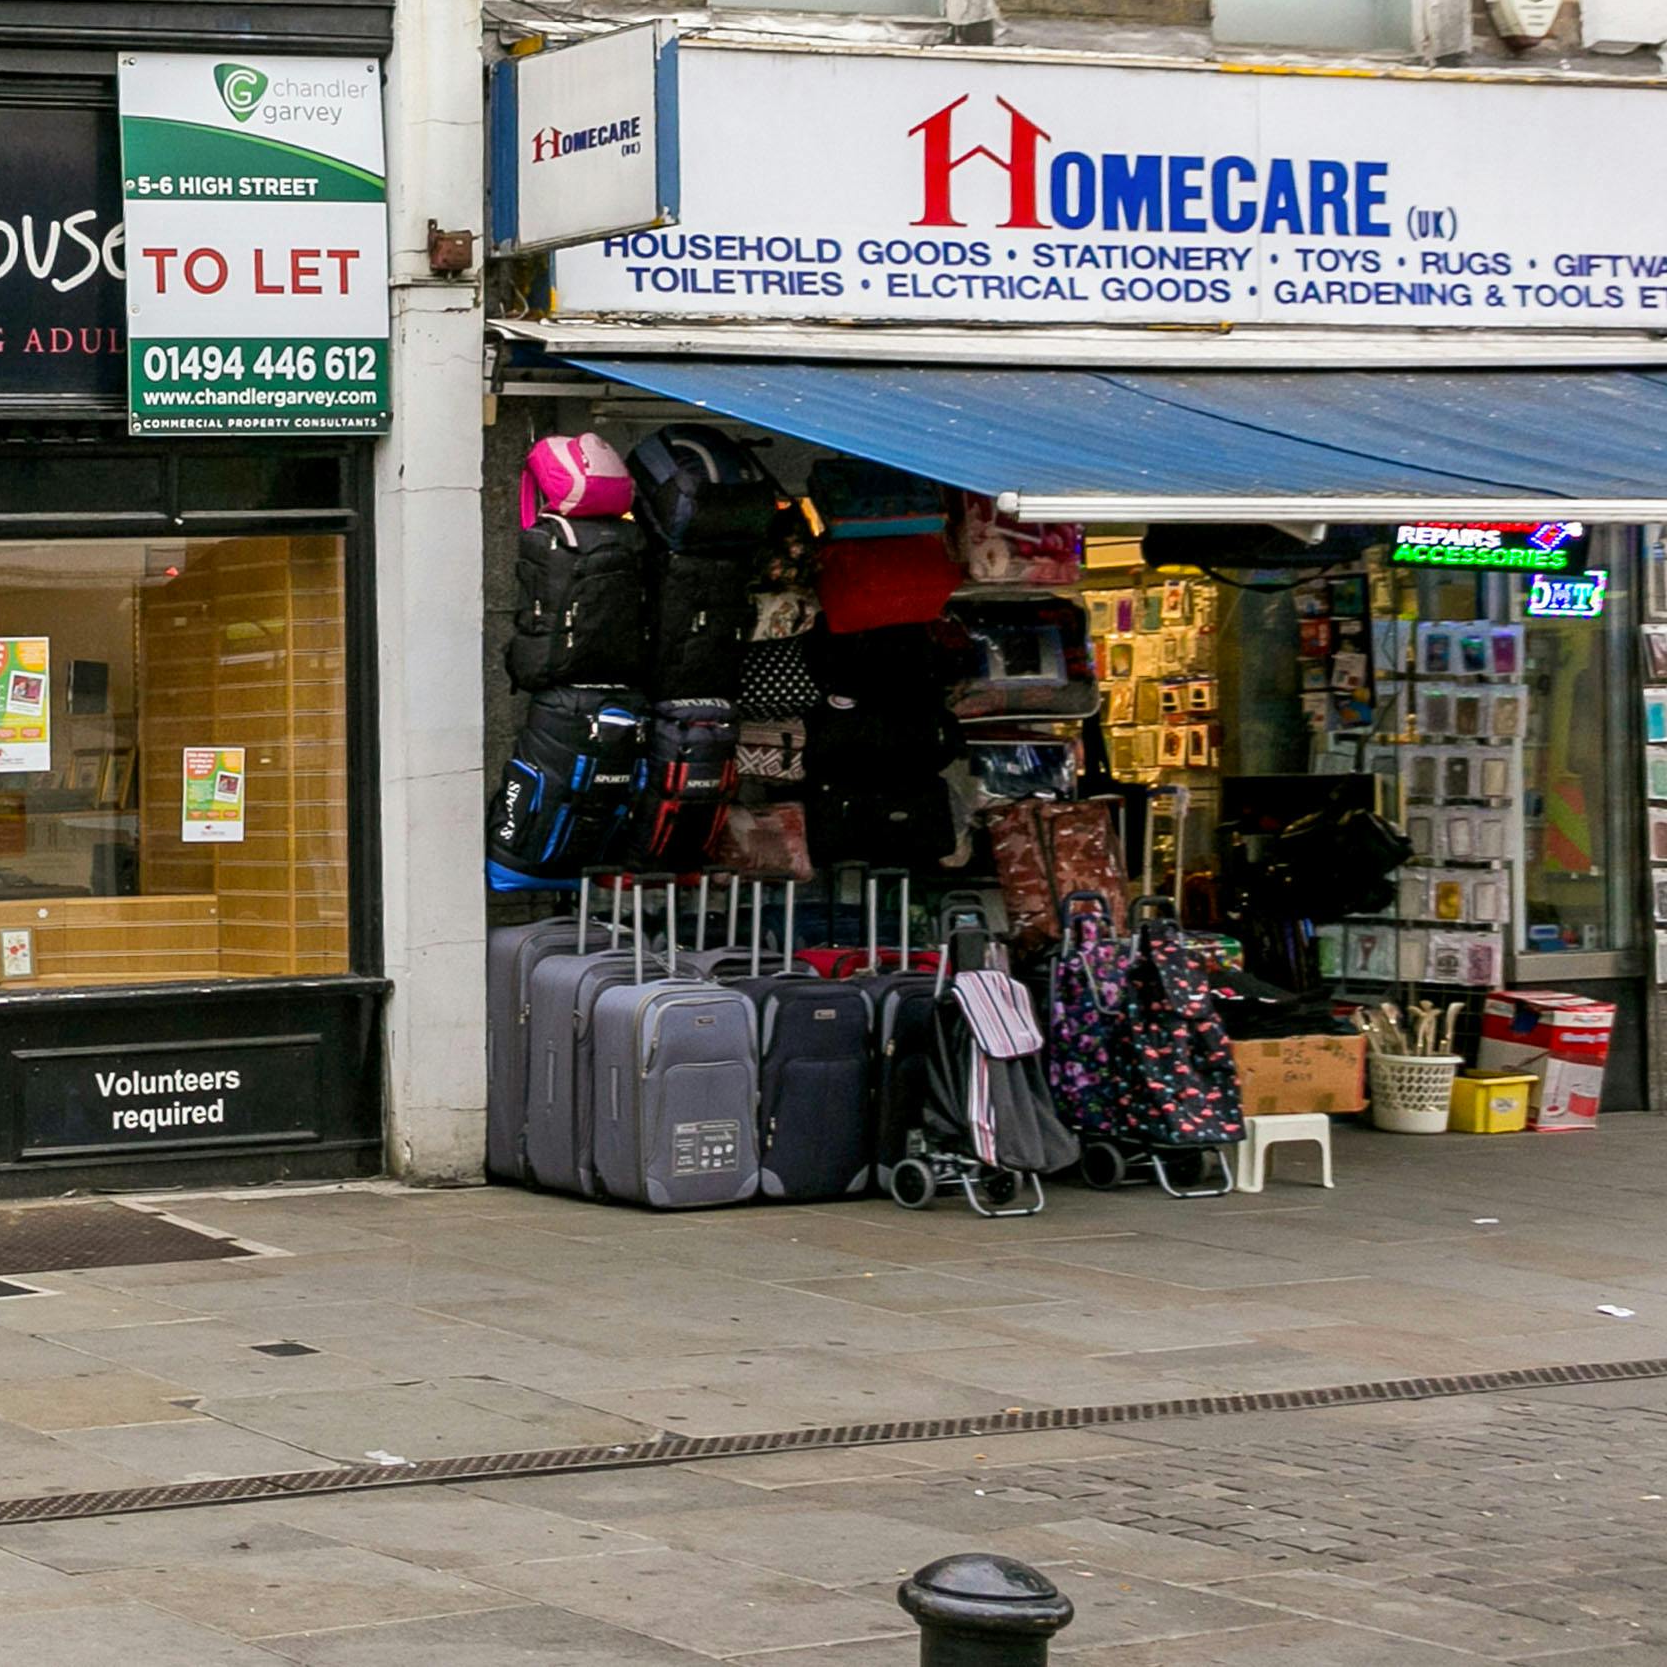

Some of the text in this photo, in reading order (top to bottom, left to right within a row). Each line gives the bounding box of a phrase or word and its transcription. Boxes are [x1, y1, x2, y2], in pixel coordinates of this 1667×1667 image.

[272, 78, 370, 100] chandler
[262, 102, 343, 125] garvey
[531, 116, 642, 163] HOMECARE
[906, 93, 1459, 242] HOMECARE (UK)
[137, 176, 319, 196] 5-6 HIGH STREET
[142, 247, 361, 295] TO LET
[603, 233, 842, 263] HOUSEHOLD
[857, 238, 992, 267] GOODS
[1032, 242, 1252, 272] STATIONERY
[1293, 247, 1382, 274] TOYS
[1420, 251, 1512, 277] RUGS
[625, 266, 845, 296] TOILETRIES
[886, 272, 1089, 301] ELCTRICAL
[1100, 277, 1232, 304] GOODS
[1273, 281, 1473, 308] GARDENING
[1485, 283, 1506, 308] &
[1519, 283, 1624, 309] TOOLS
[143, 345, 377, 382] 01494 446 612
[143, 387, 377, 407] www.chandlergarvey.com
[143, 417, 378, 429] COMMERCIAL PROPERTY CONSULTANTS
[1396, 524, 1502, 548] REPAIRS
[1393, 543, 1568, 570] ACCESSORIES
[95, 1067, 241, 1100] Volunteers
[112, 1099, 225, 1133] required
